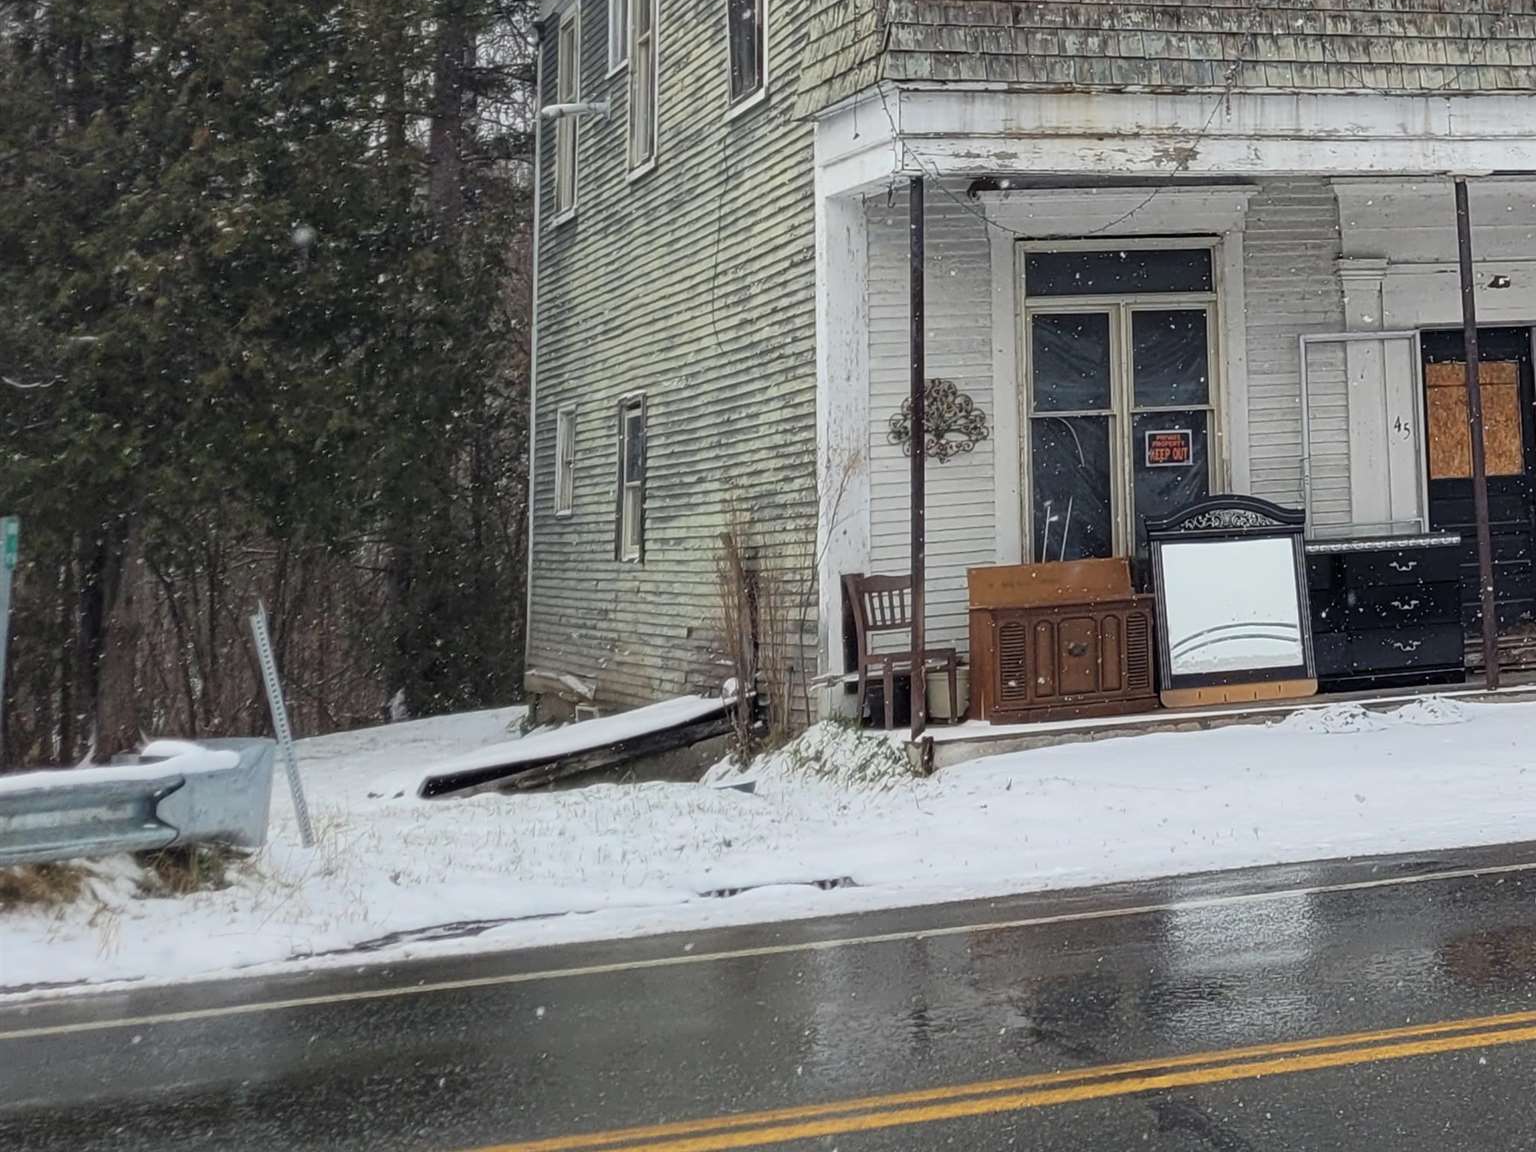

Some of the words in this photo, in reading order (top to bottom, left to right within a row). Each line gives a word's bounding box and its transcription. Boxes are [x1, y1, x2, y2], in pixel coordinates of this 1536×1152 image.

[1393, 415, 1411, 440] 45
[1149, 448, 1171, 462] KEEP
[1172, 447, 1188, 461] OUT
